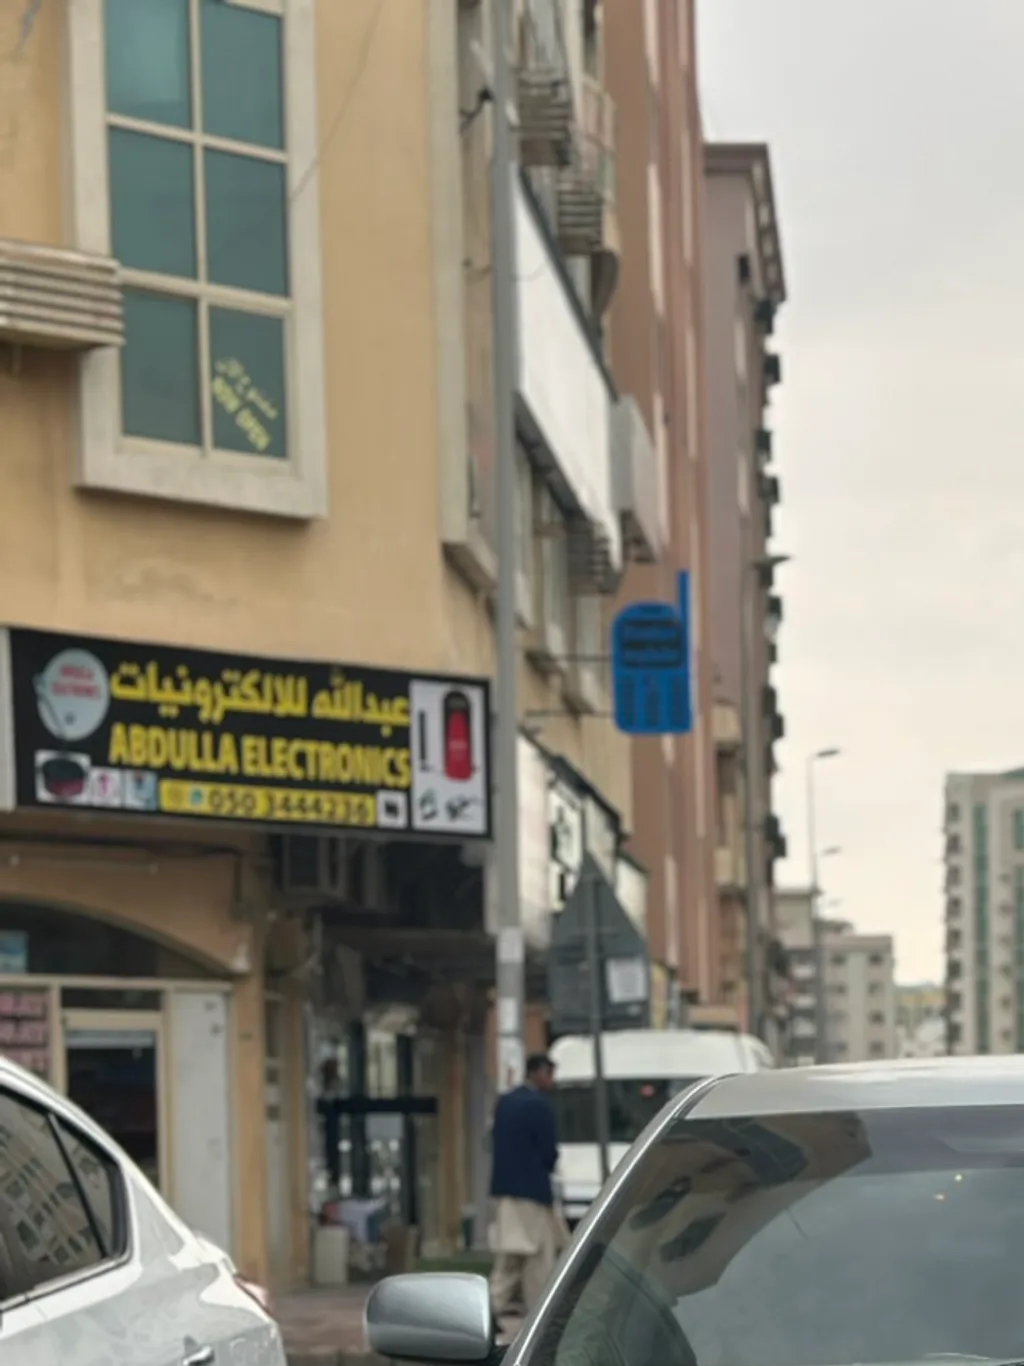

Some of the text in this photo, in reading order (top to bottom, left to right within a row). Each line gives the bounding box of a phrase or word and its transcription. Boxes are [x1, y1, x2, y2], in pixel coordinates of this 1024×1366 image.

[312, 666, 410, 737] عبدالله
[108, 722, 411, 788] ABDULLA ELECTRONICS
